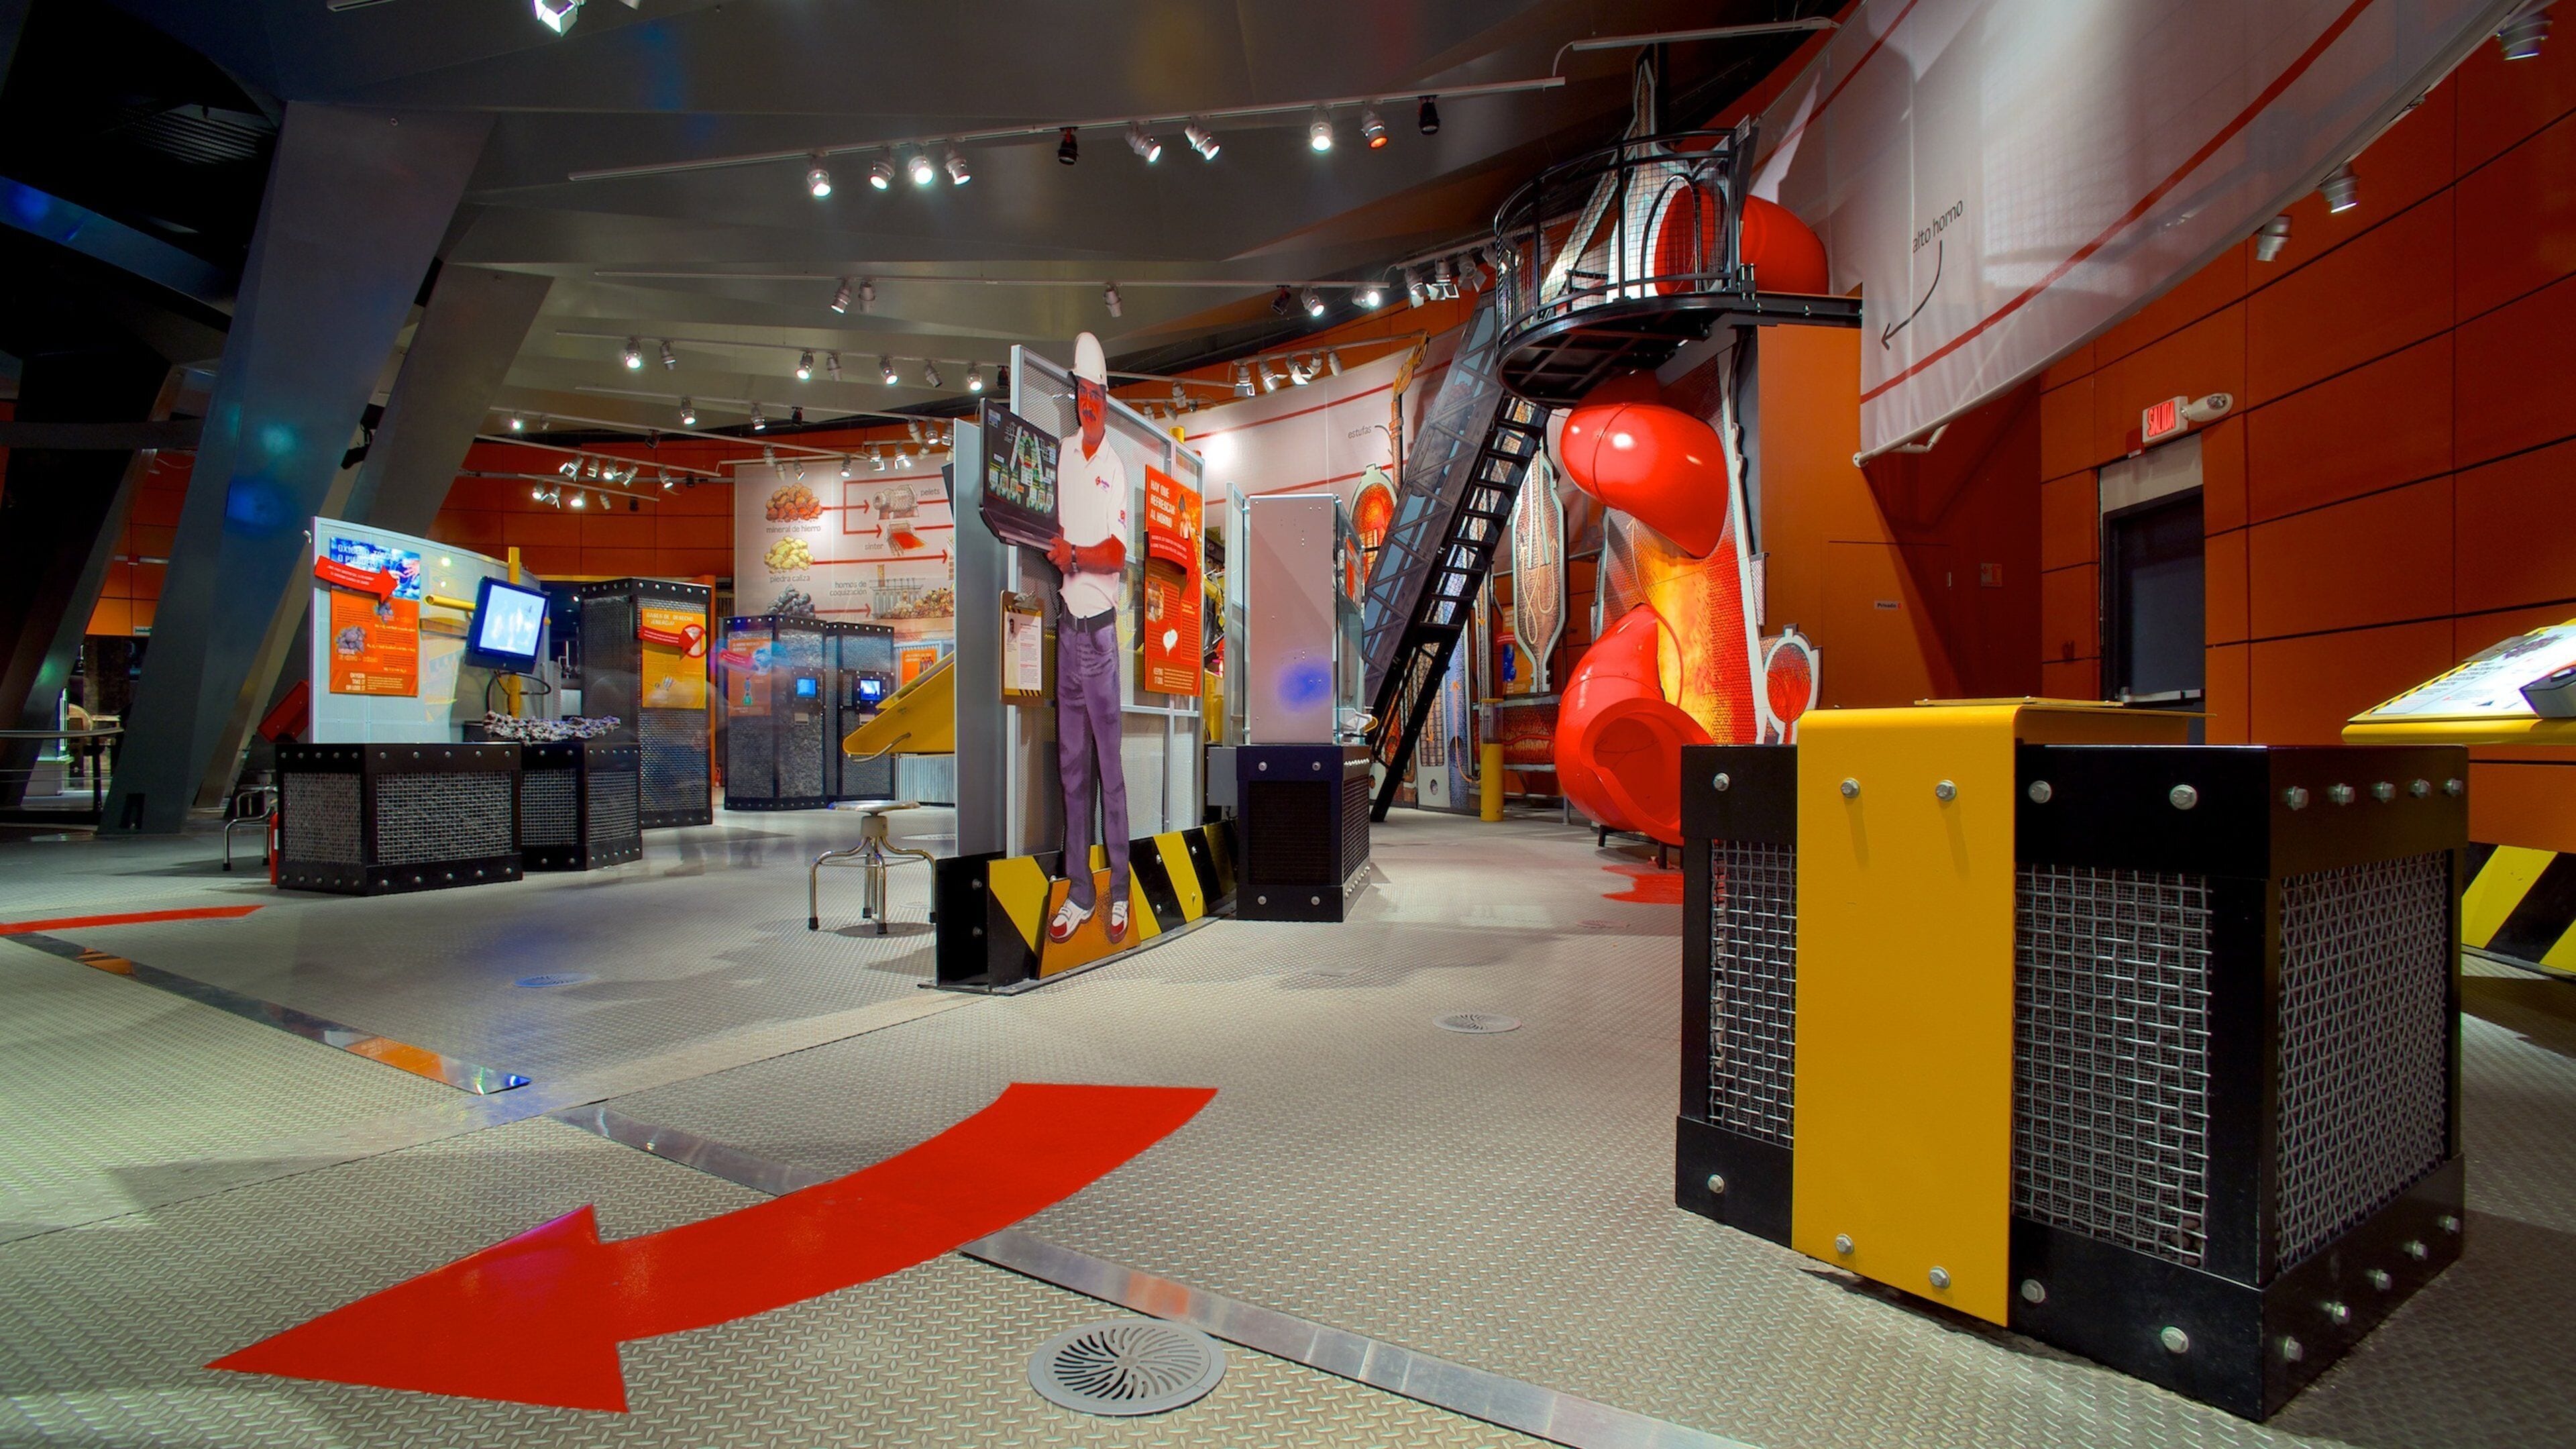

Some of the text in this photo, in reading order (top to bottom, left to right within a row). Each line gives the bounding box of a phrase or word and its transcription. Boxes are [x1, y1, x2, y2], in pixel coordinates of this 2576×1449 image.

[1913, 200, 1963, 254] alto horno
[2147, 400, 2176, 437] SALIDA
[1348, 425, 1372, 439] estufas
[920, 488, 941, 496] pelets
[1150, 479, 1160, 494] HAY
[1150, 494, 1175, 515] REFRESCAR
[801, 525, 821, 533] hierro
